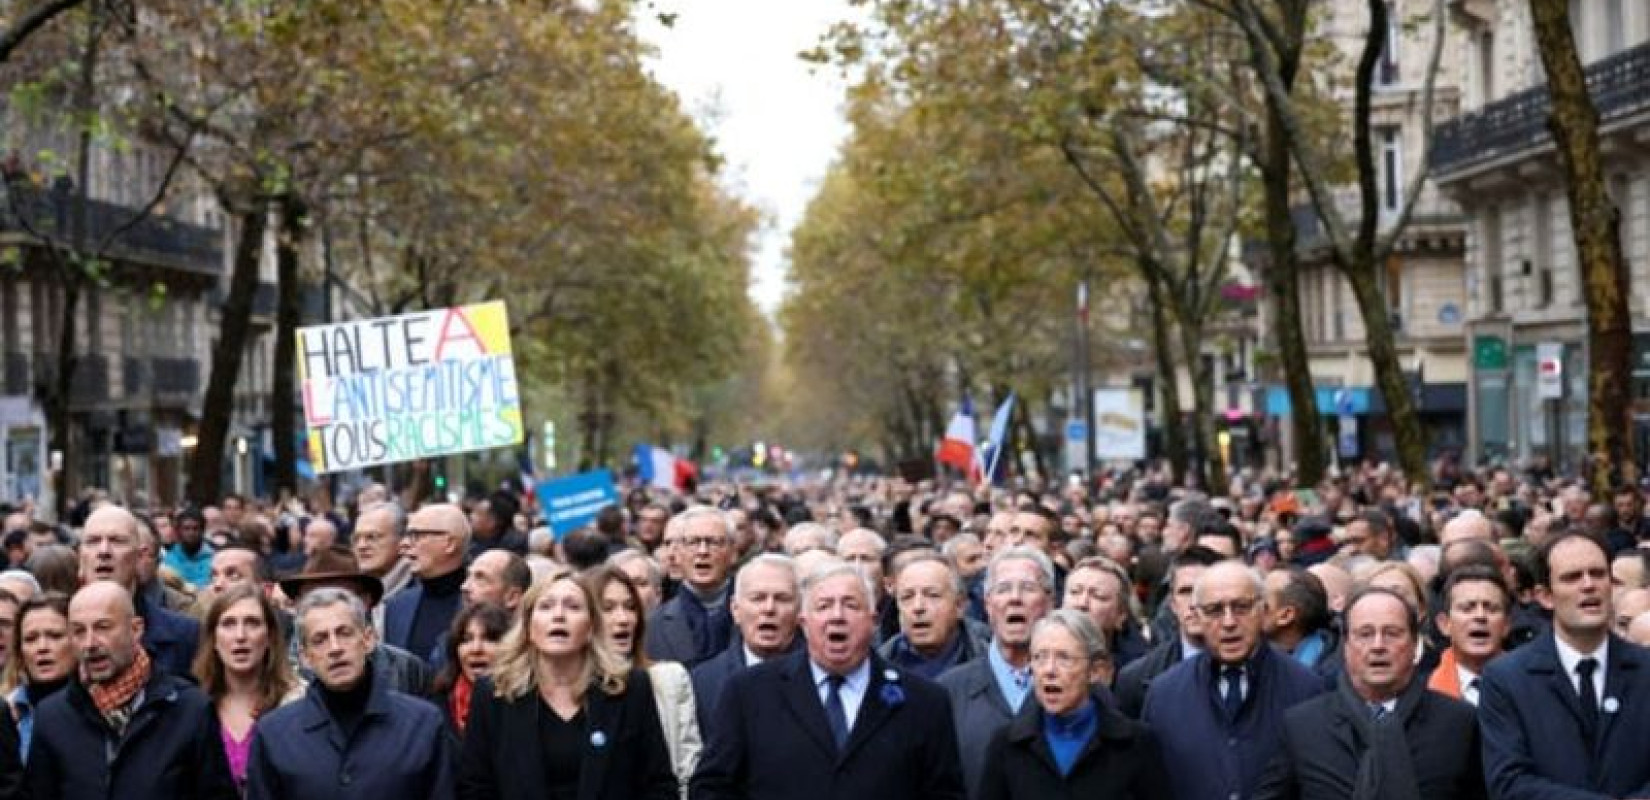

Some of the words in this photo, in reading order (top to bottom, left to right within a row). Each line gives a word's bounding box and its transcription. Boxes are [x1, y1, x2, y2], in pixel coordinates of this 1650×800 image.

[301, 316, 431, 379] HALTE
[308, 419, 388, 471] TOUS
[385, 409, 517, 460] RACISMES
